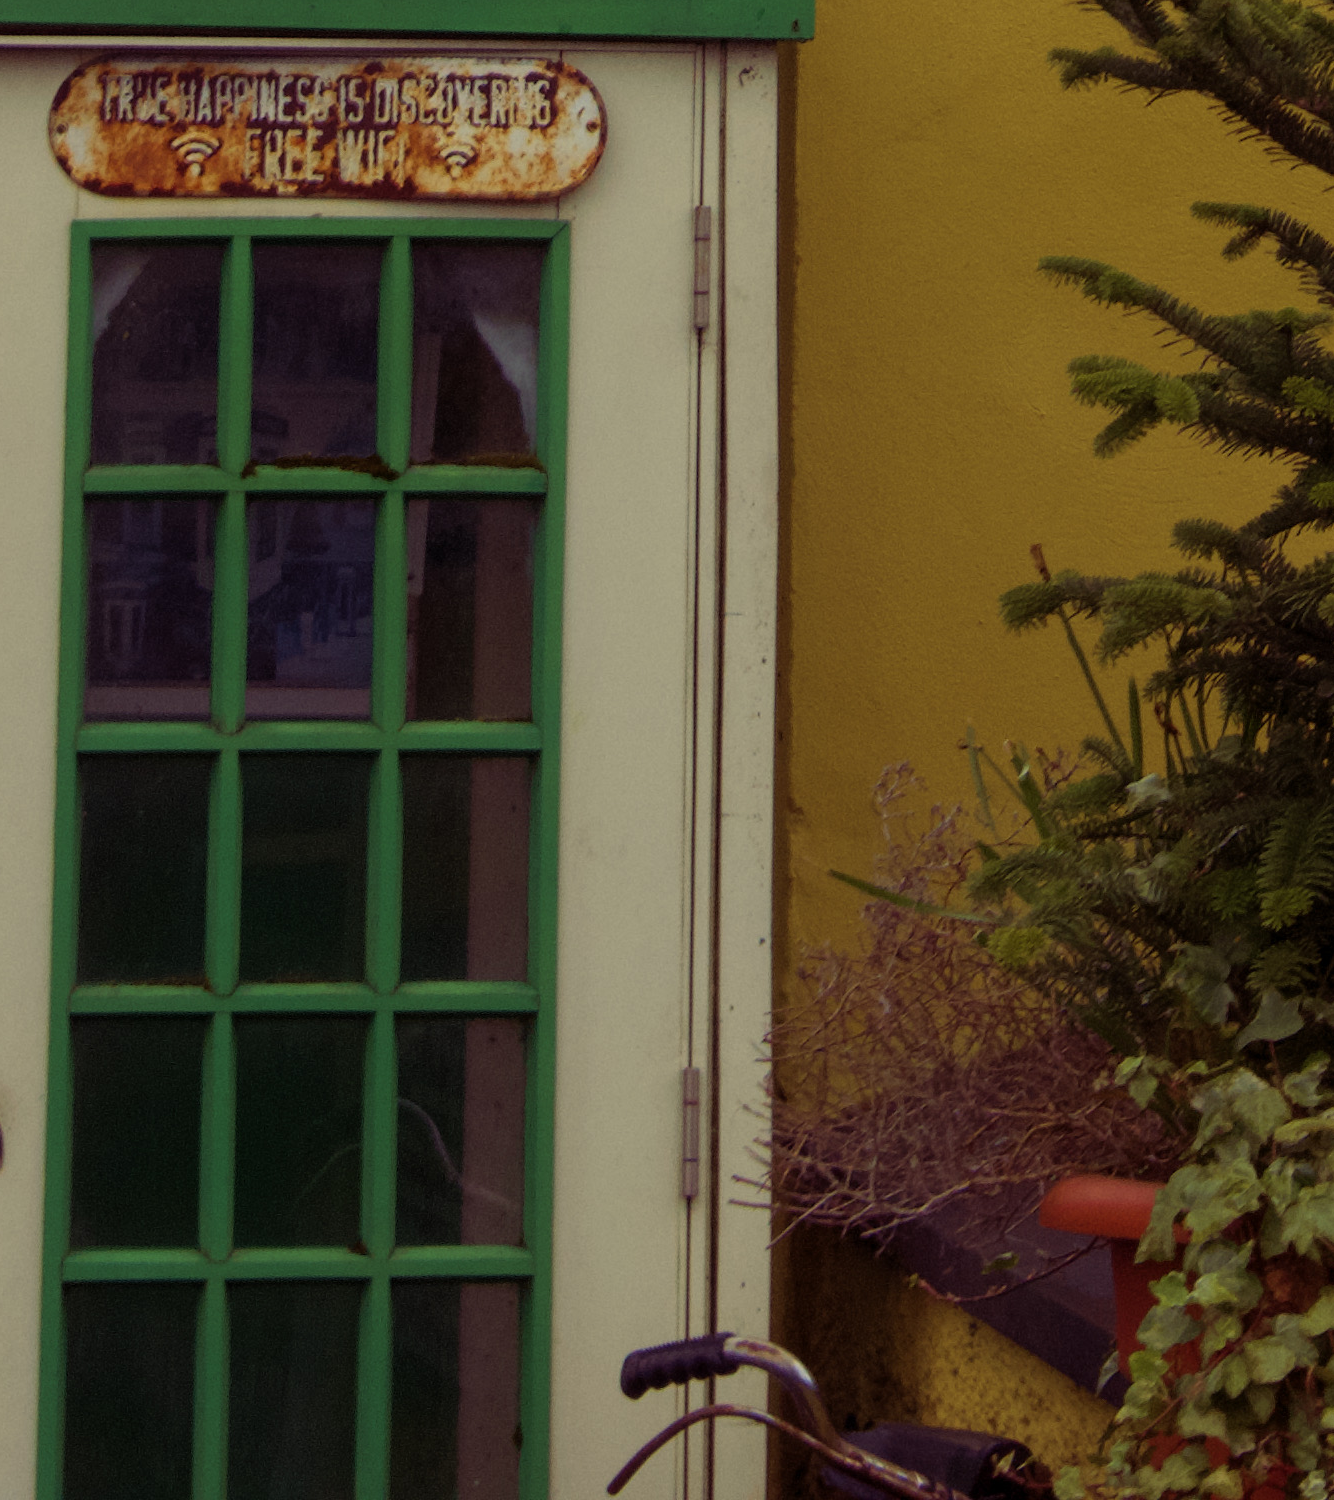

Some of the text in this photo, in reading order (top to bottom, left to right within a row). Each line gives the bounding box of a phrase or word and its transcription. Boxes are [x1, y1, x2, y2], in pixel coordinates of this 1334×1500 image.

[102, 73, 552, 127] TRUE HAPPINESS IS DISCOVERING
[243, 128, 408, 186] FREE WIFI
